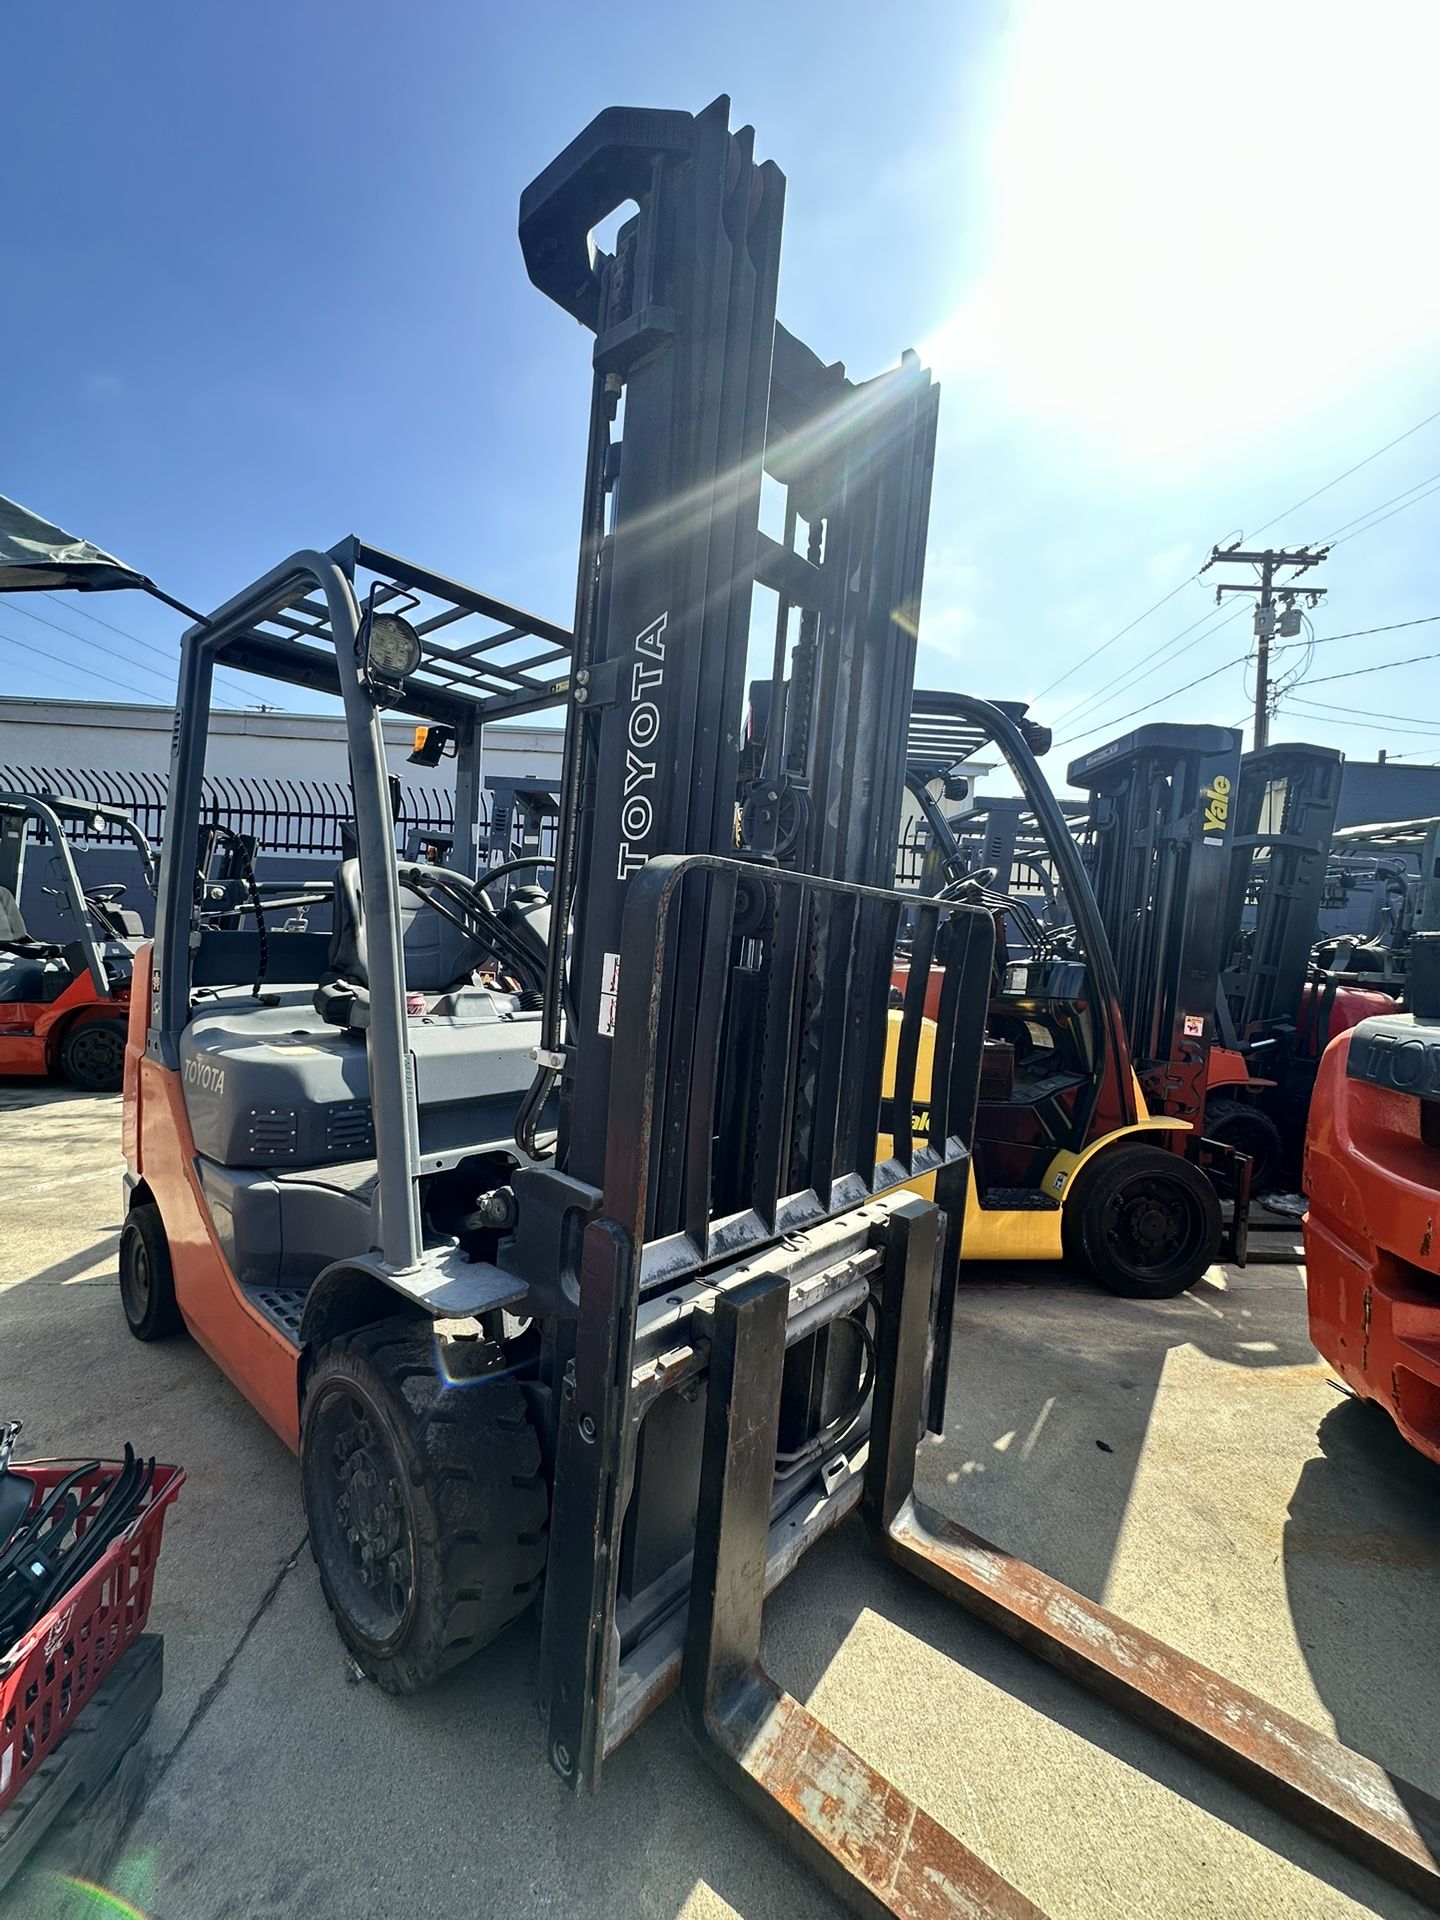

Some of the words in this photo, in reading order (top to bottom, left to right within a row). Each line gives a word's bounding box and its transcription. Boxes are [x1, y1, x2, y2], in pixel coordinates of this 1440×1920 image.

[617, 611, 668, 880] TOYOTA
[1203, 775, 1231, 831] Yale
[184, 1058, 225, 1095] TOYOTA
